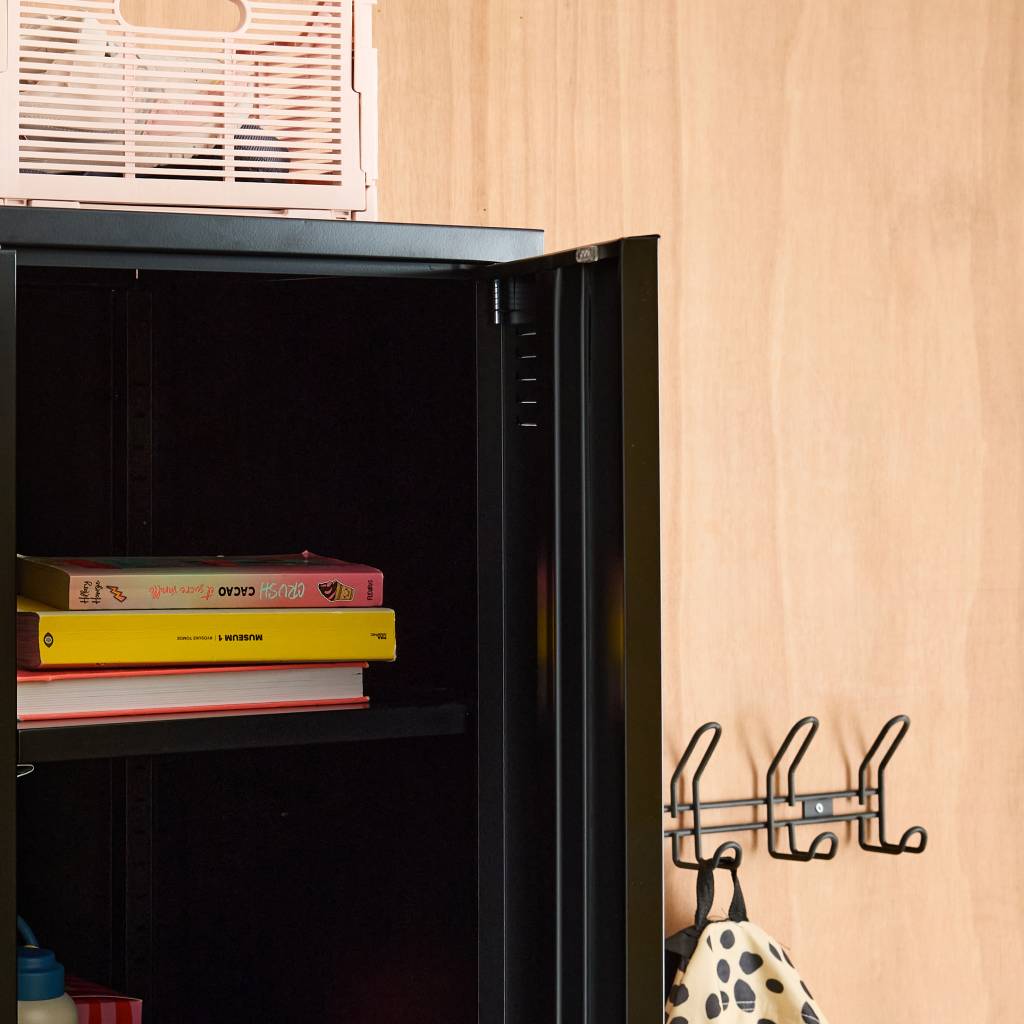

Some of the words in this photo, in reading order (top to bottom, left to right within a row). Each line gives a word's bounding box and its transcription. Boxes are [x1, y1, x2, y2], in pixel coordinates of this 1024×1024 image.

[218, 586, 256, 597] CACAO
[260, 582, 305, 600] CRUSH
[218, 634, 223, 642] 1
[224, 634, 263, 642] MUSEUM
